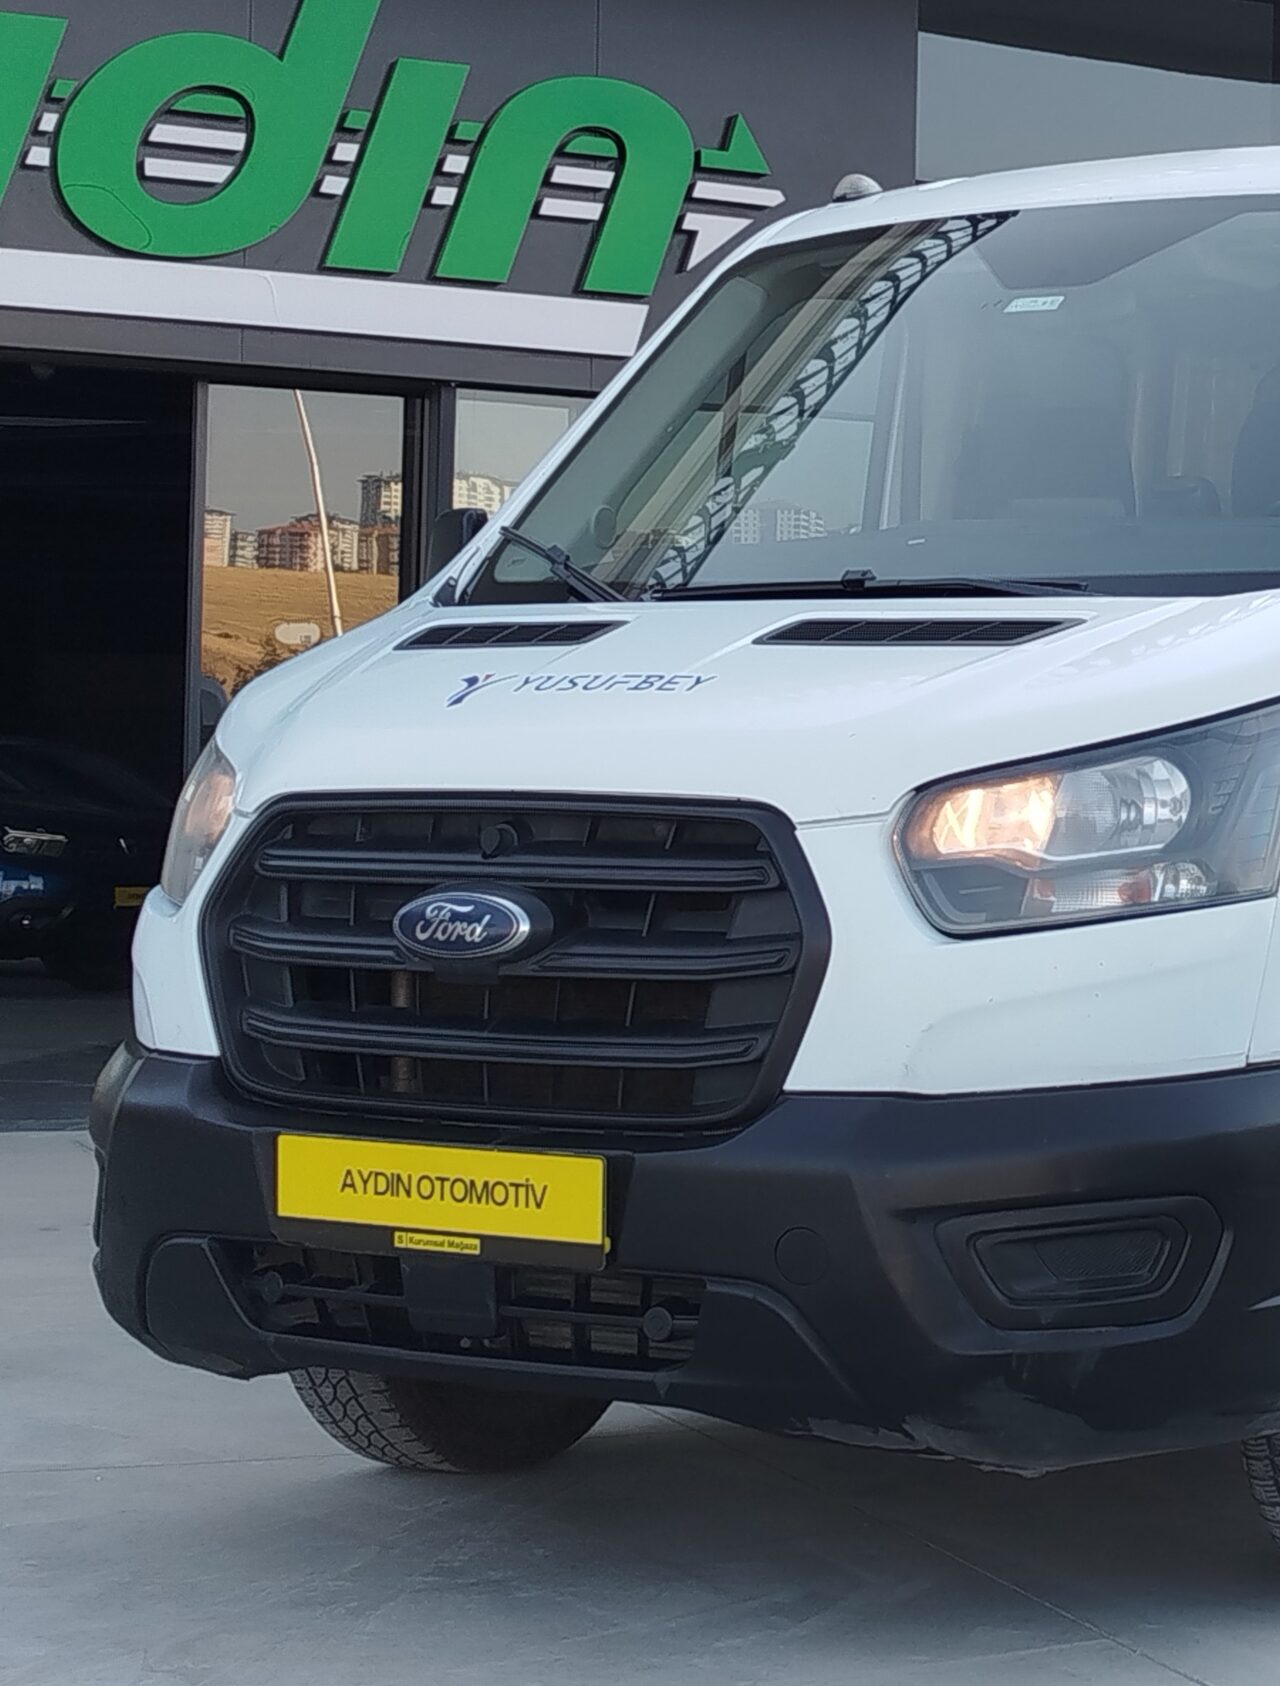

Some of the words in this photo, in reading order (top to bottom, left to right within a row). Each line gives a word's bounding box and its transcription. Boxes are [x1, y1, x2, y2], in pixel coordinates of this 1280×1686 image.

[514, 673, 718, 692] YUSUFBEY
[415, 902, 491, 944] Ford
[339, 1168, 412, 1199] AYDIN
[416, 1174, 549, 1210] OTOMOTİV
